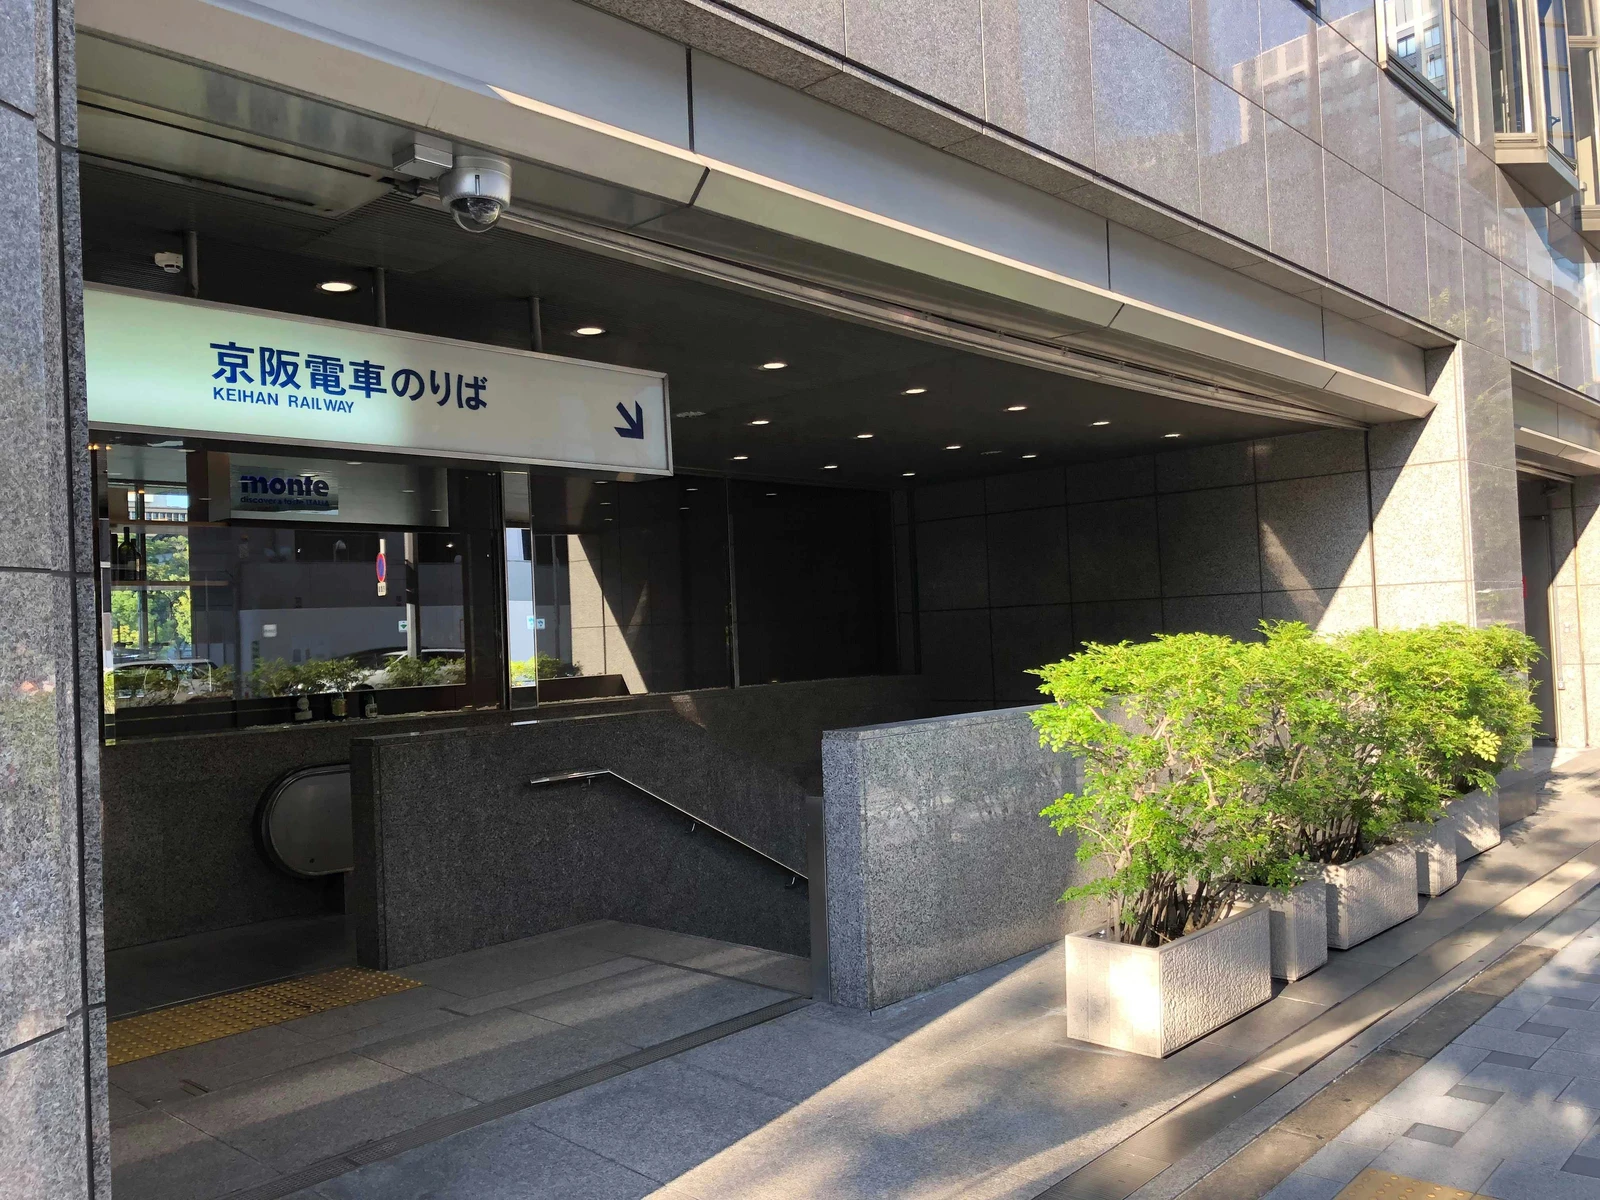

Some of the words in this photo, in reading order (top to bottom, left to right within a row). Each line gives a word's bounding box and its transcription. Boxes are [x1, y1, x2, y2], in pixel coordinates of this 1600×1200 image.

[209, 341, 488, 411] 京阪電車のりば
[212, 386, 279, 406] KEIHAN
[288, 394, 354, 414] RAILWAY
[240, 475, 330, 497] monte
[240, 495, 277, 505] discover
